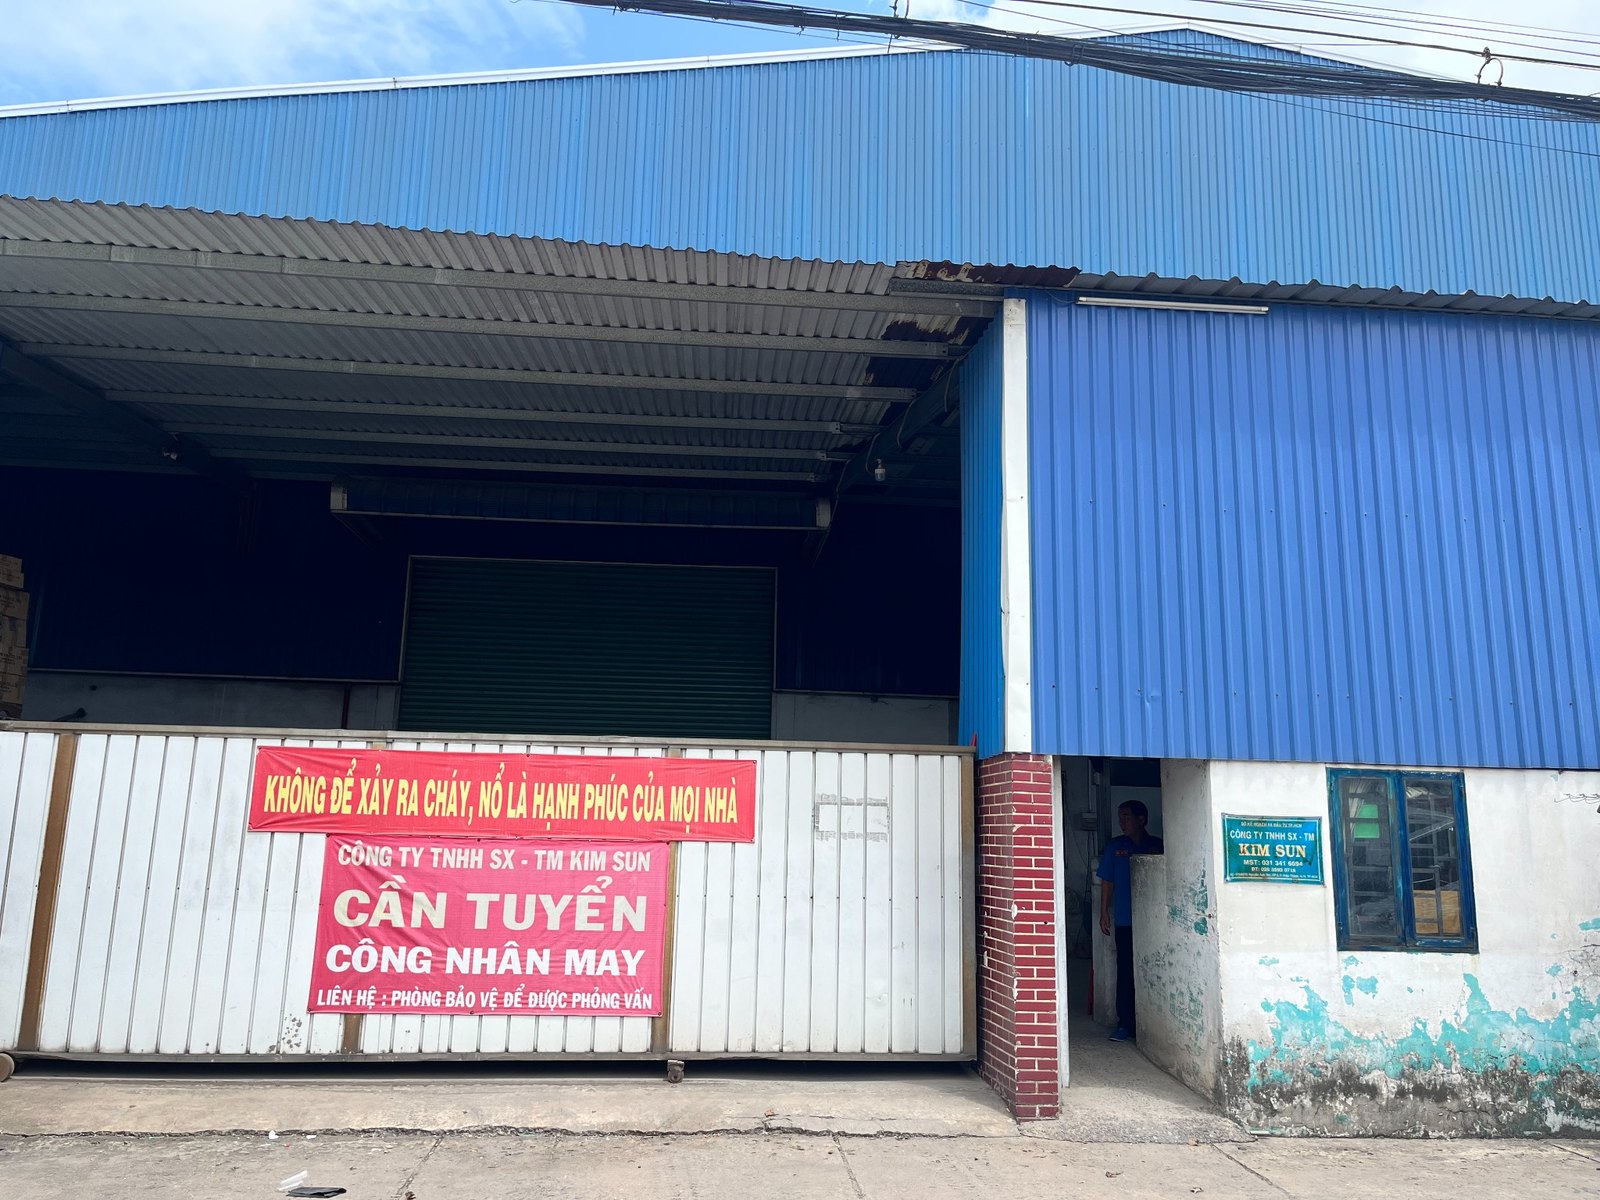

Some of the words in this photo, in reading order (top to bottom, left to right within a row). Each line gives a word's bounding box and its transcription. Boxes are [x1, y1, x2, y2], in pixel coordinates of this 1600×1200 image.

[263, 767, 326, 814] KHÔNG
[329, 758, 356, 815] ĐỂ
[356, 763, 394, 816] XẢY
[396, 779, 419, 816] RA
[423, 769, 474, 826] CHÁY,
[478, 762, 505, 818] NỔ
[506, 771, 527, 819] LÀ
[532, 782, 580, 831] HẠNH
[583, 774, 629, 822] PHÚC
[632, 770, 665, 822] CỦA
[669, 785, 700, 833] MỌI
[704, 777, 738, 824] NHÀ
[1230, 829, 1251, 839] CÔNG
[1254, 831, 1263, 840] TY
[1265, 831, 1286, 840] TNHH
[1287, 832, 1297, 841] SX
[1304, 832, 1315, 841] TM
[1238, 843, 1271, 857] KIM
[1275, 844, 1307, 858] SUN
[338, 840, 392, 867] CÔNG
[398, 846, 425, 868] TY
[430, 847, 483, 869] TNHH
[489, 849, 515, 869] SX
[534, 850, 563, 870] TM
[570, 850, 607, 871] KIM
[612, 851, 650, 872] SUN
[333, 874, 448, 929] CẦN
[466, 875, 647, 932] TUYỂN
[325, 937, 433, 974] CÔNG
[445, 940, 550, 975] NHÂN
[564, 949, 646, 976] MAY
[316, 985, 353, 1006] LIÊN
[356, 985, 377, 1010] HỆ
[391, 986, 442, 1008] PHÒNG
[445, 985, 476, 1008] BẢO
[480, 987, 499, 1011] VỆ
[503, 983, 525, 1009] ĐỂ
[528, 990, 569, 1011] ĐƯỢC
[571, 986, 620, 1009] PHỎNG
[624, 987, 652, 1010] VẤN
